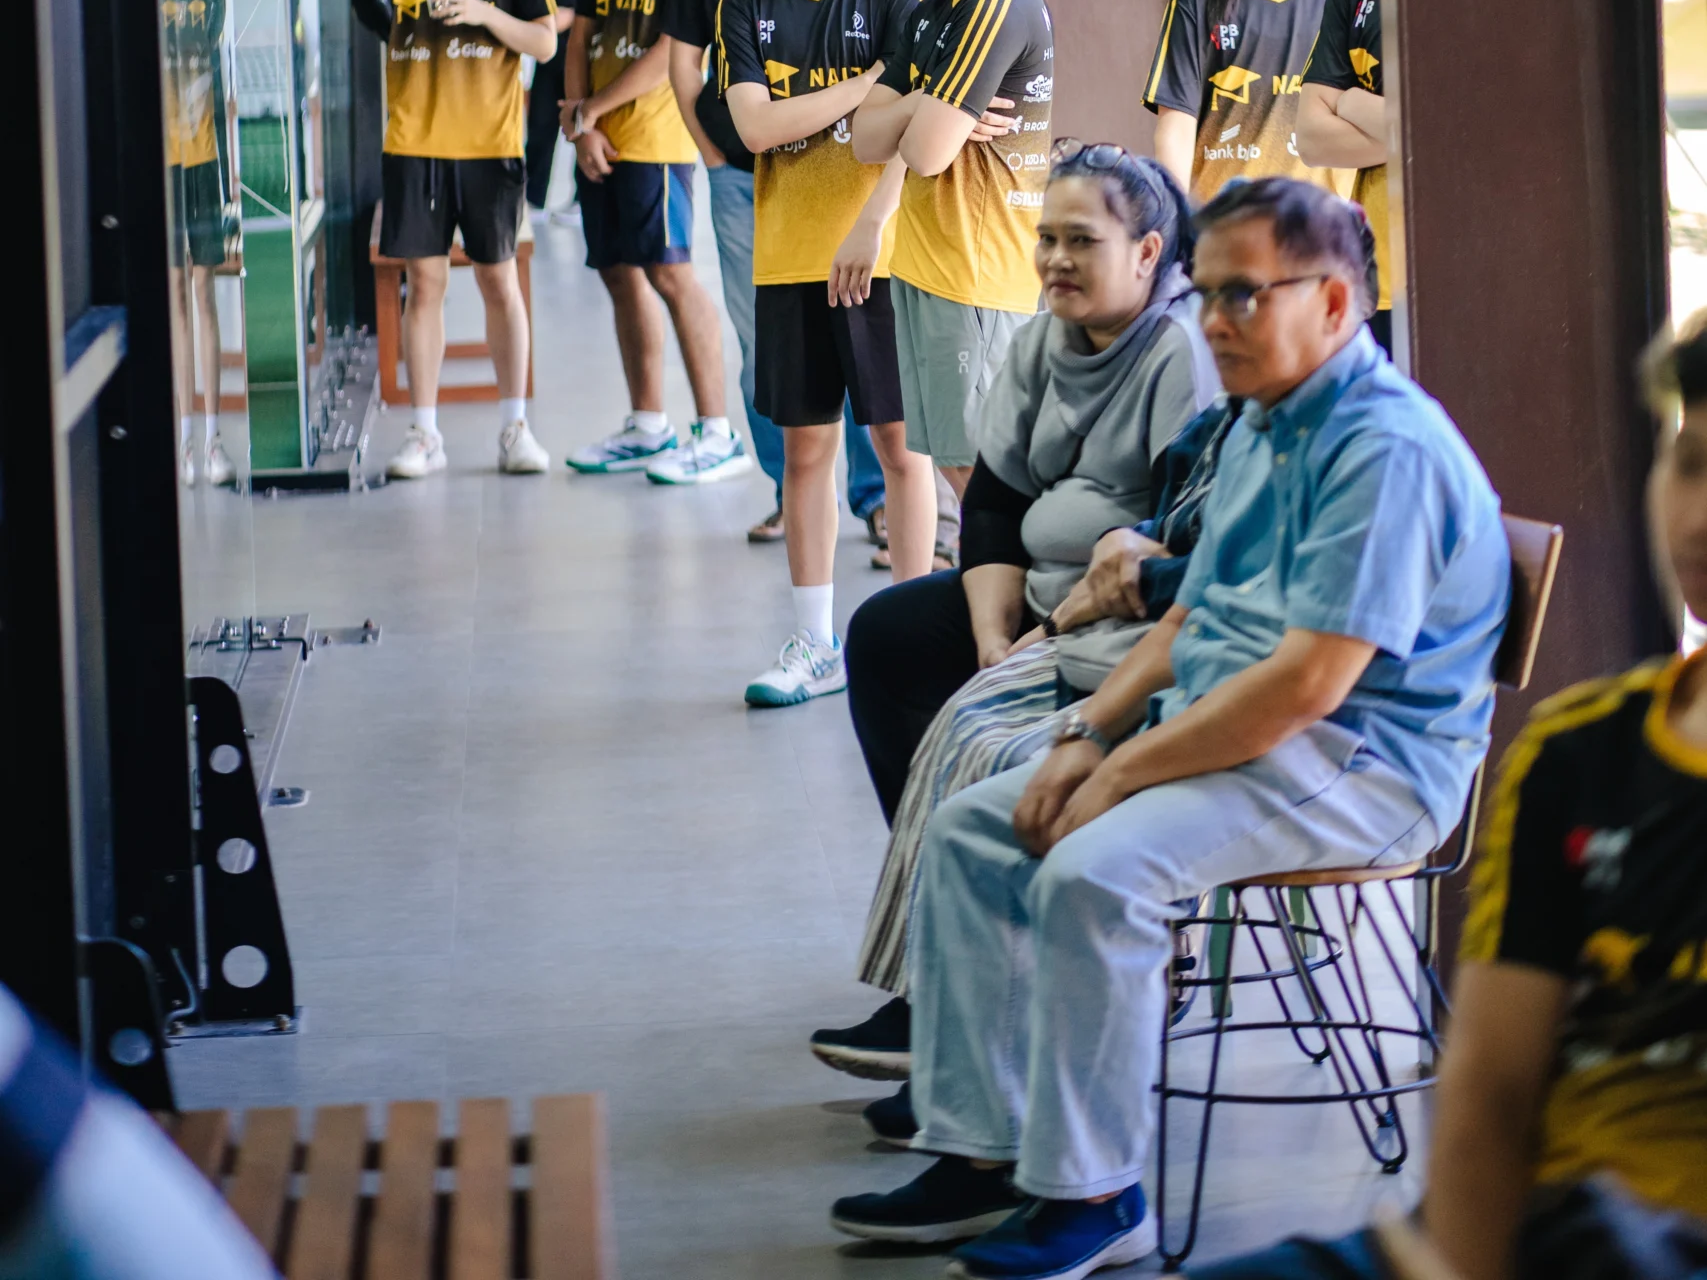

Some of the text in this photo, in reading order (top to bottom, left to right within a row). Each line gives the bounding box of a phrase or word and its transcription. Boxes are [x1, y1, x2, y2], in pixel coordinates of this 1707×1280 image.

[759, 19, 776, 32] PB
[1219, 23, 1240, 37] PB
[759, 32, 772, 44] PI
[1220, 37, 1236, 51] PI
